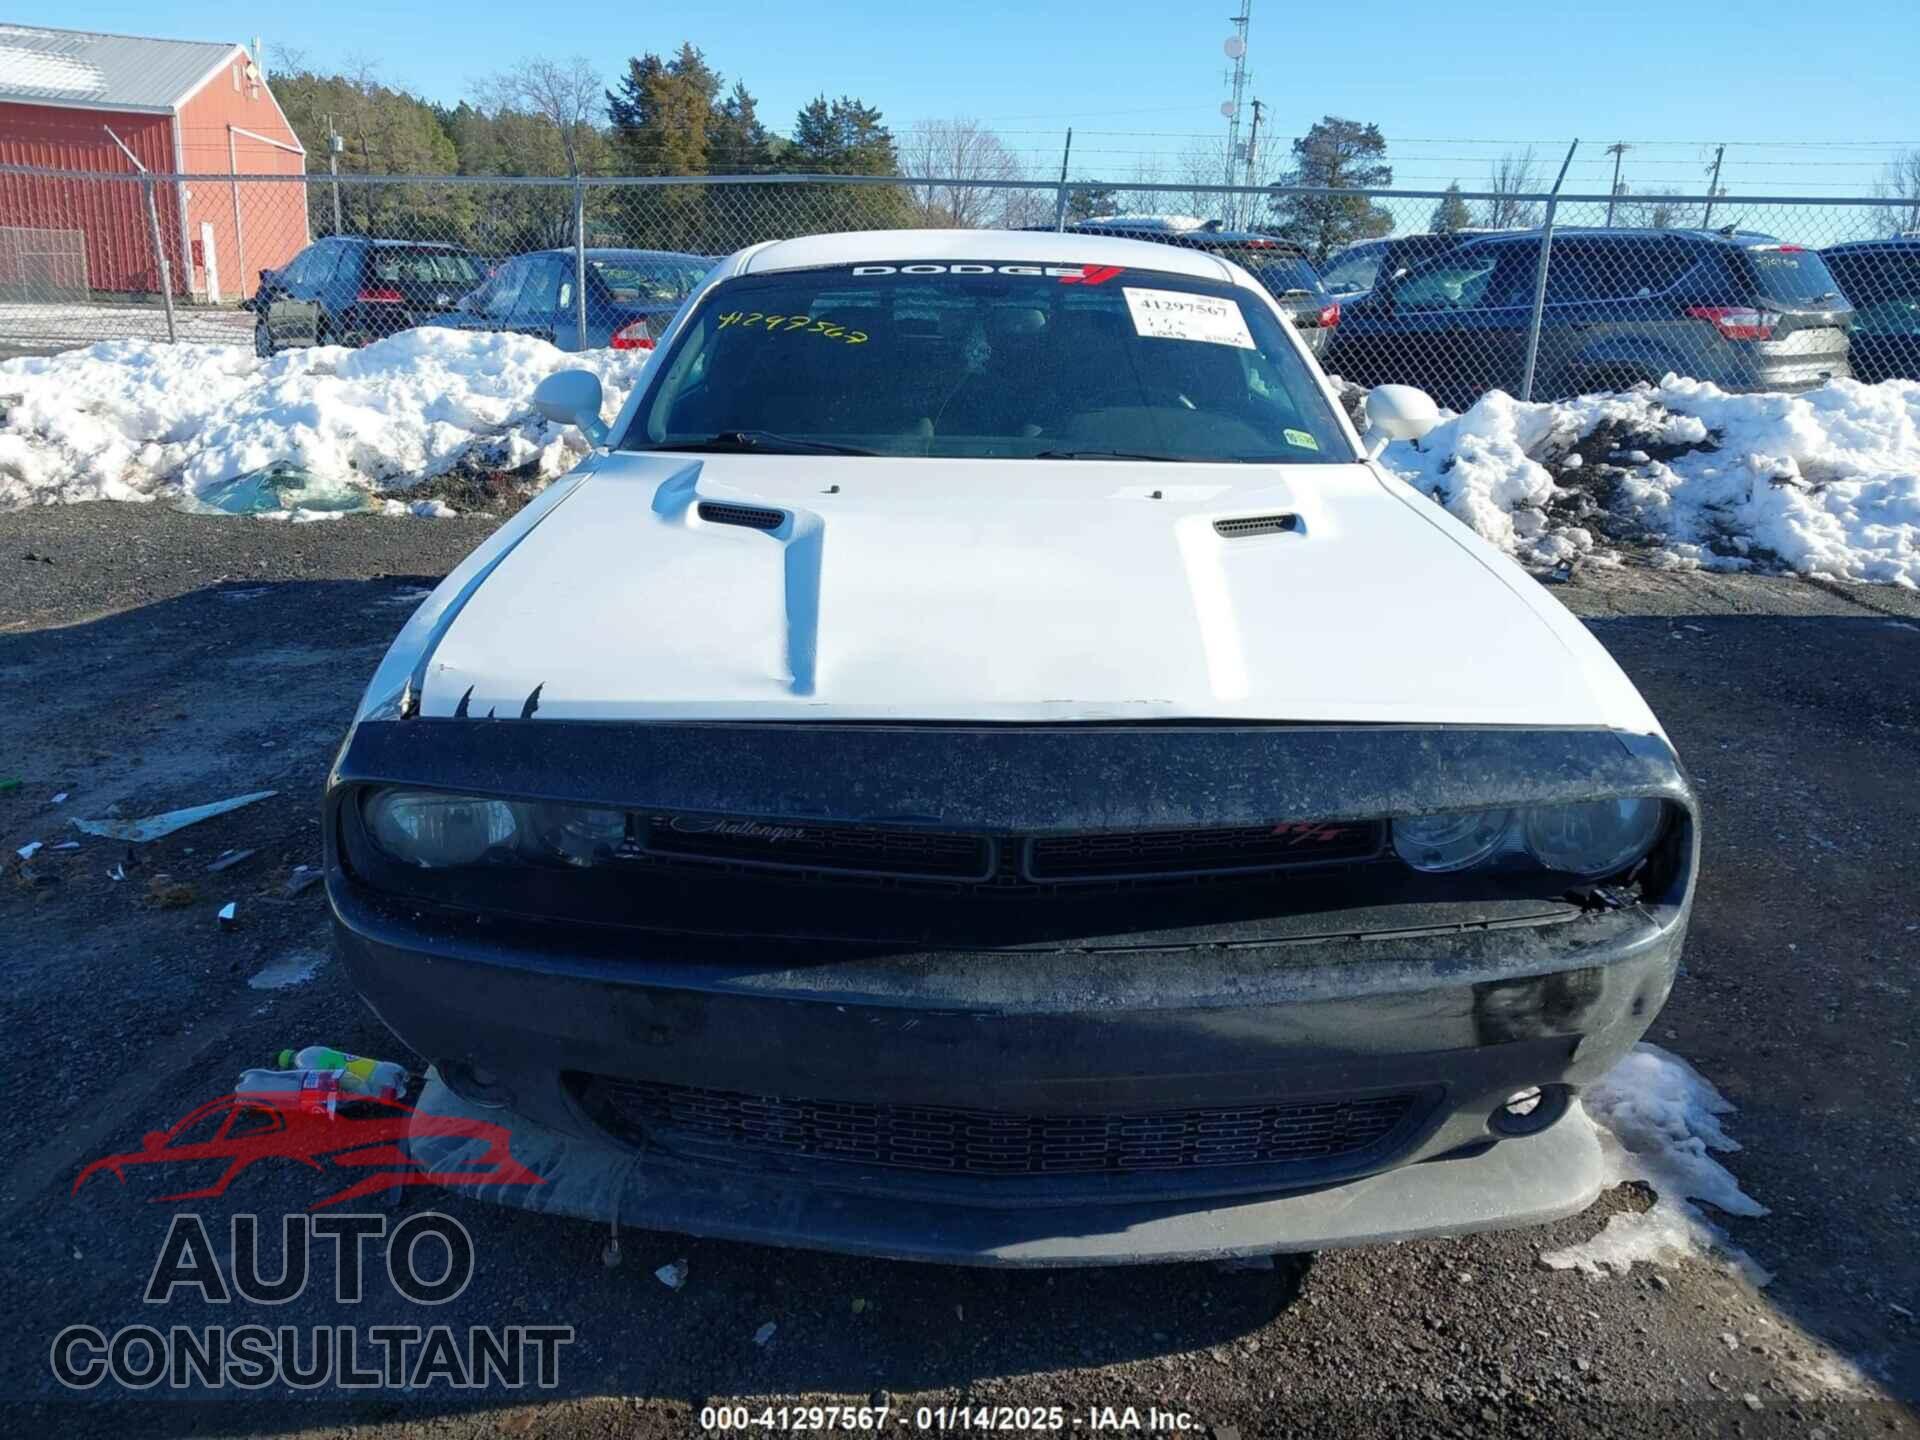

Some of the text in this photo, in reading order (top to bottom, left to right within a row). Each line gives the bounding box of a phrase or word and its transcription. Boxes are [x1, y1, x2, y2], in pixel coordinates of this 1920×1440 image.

[852, 264, 1085, 277] DODGE
[1141, 299, 1227, 316] 41297567
[669, 815, 806, 842] Challenger
